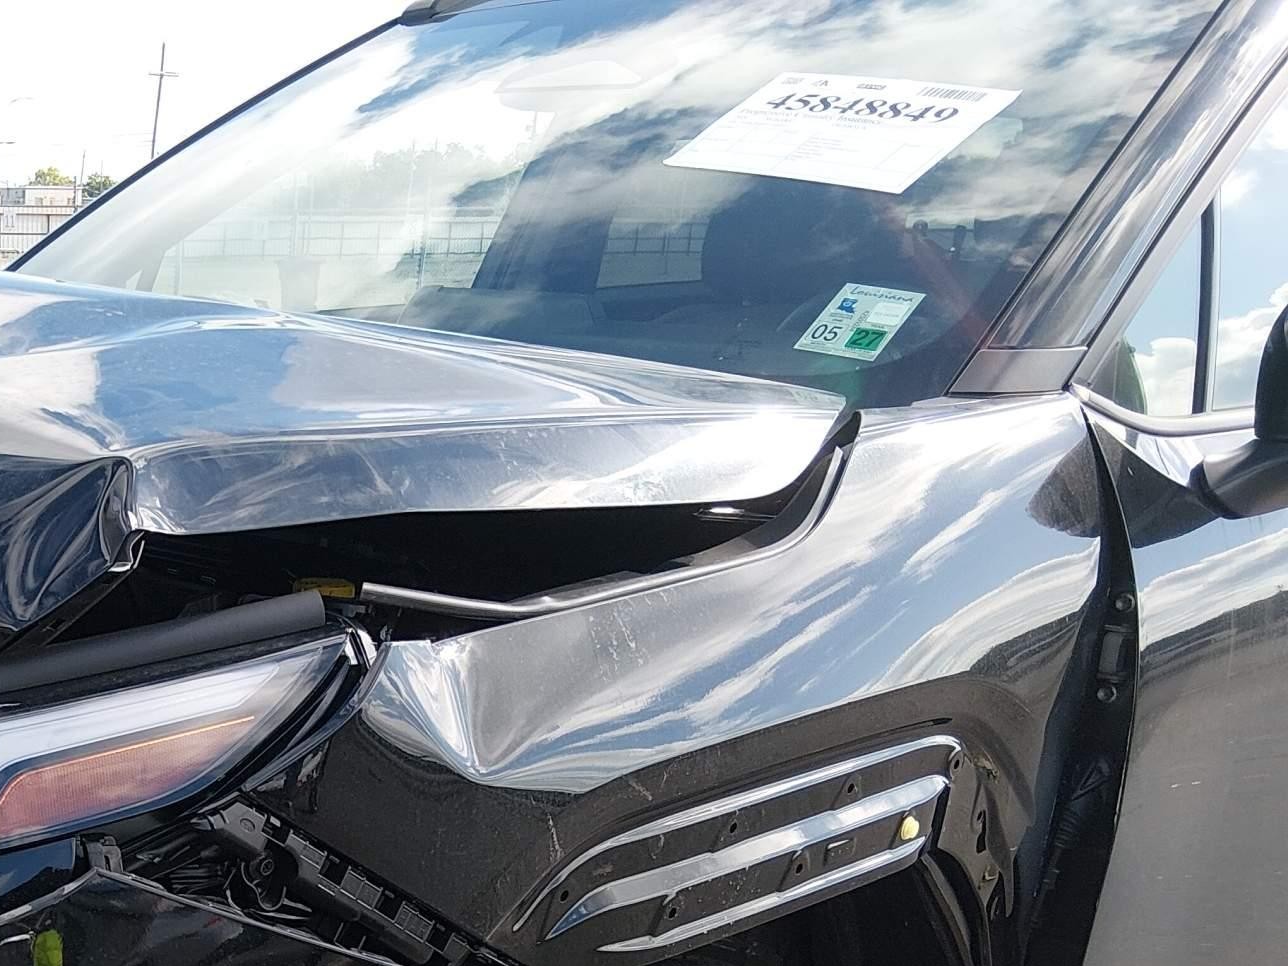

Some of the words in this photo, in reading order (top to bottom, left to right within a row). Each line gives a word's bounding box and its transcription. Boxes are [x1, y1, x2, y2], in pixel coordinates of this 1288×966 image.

[766, 92, 960, 123] 45848849
[811, 323, 843, 342] 05
[852, 329, 884, 348] 27
